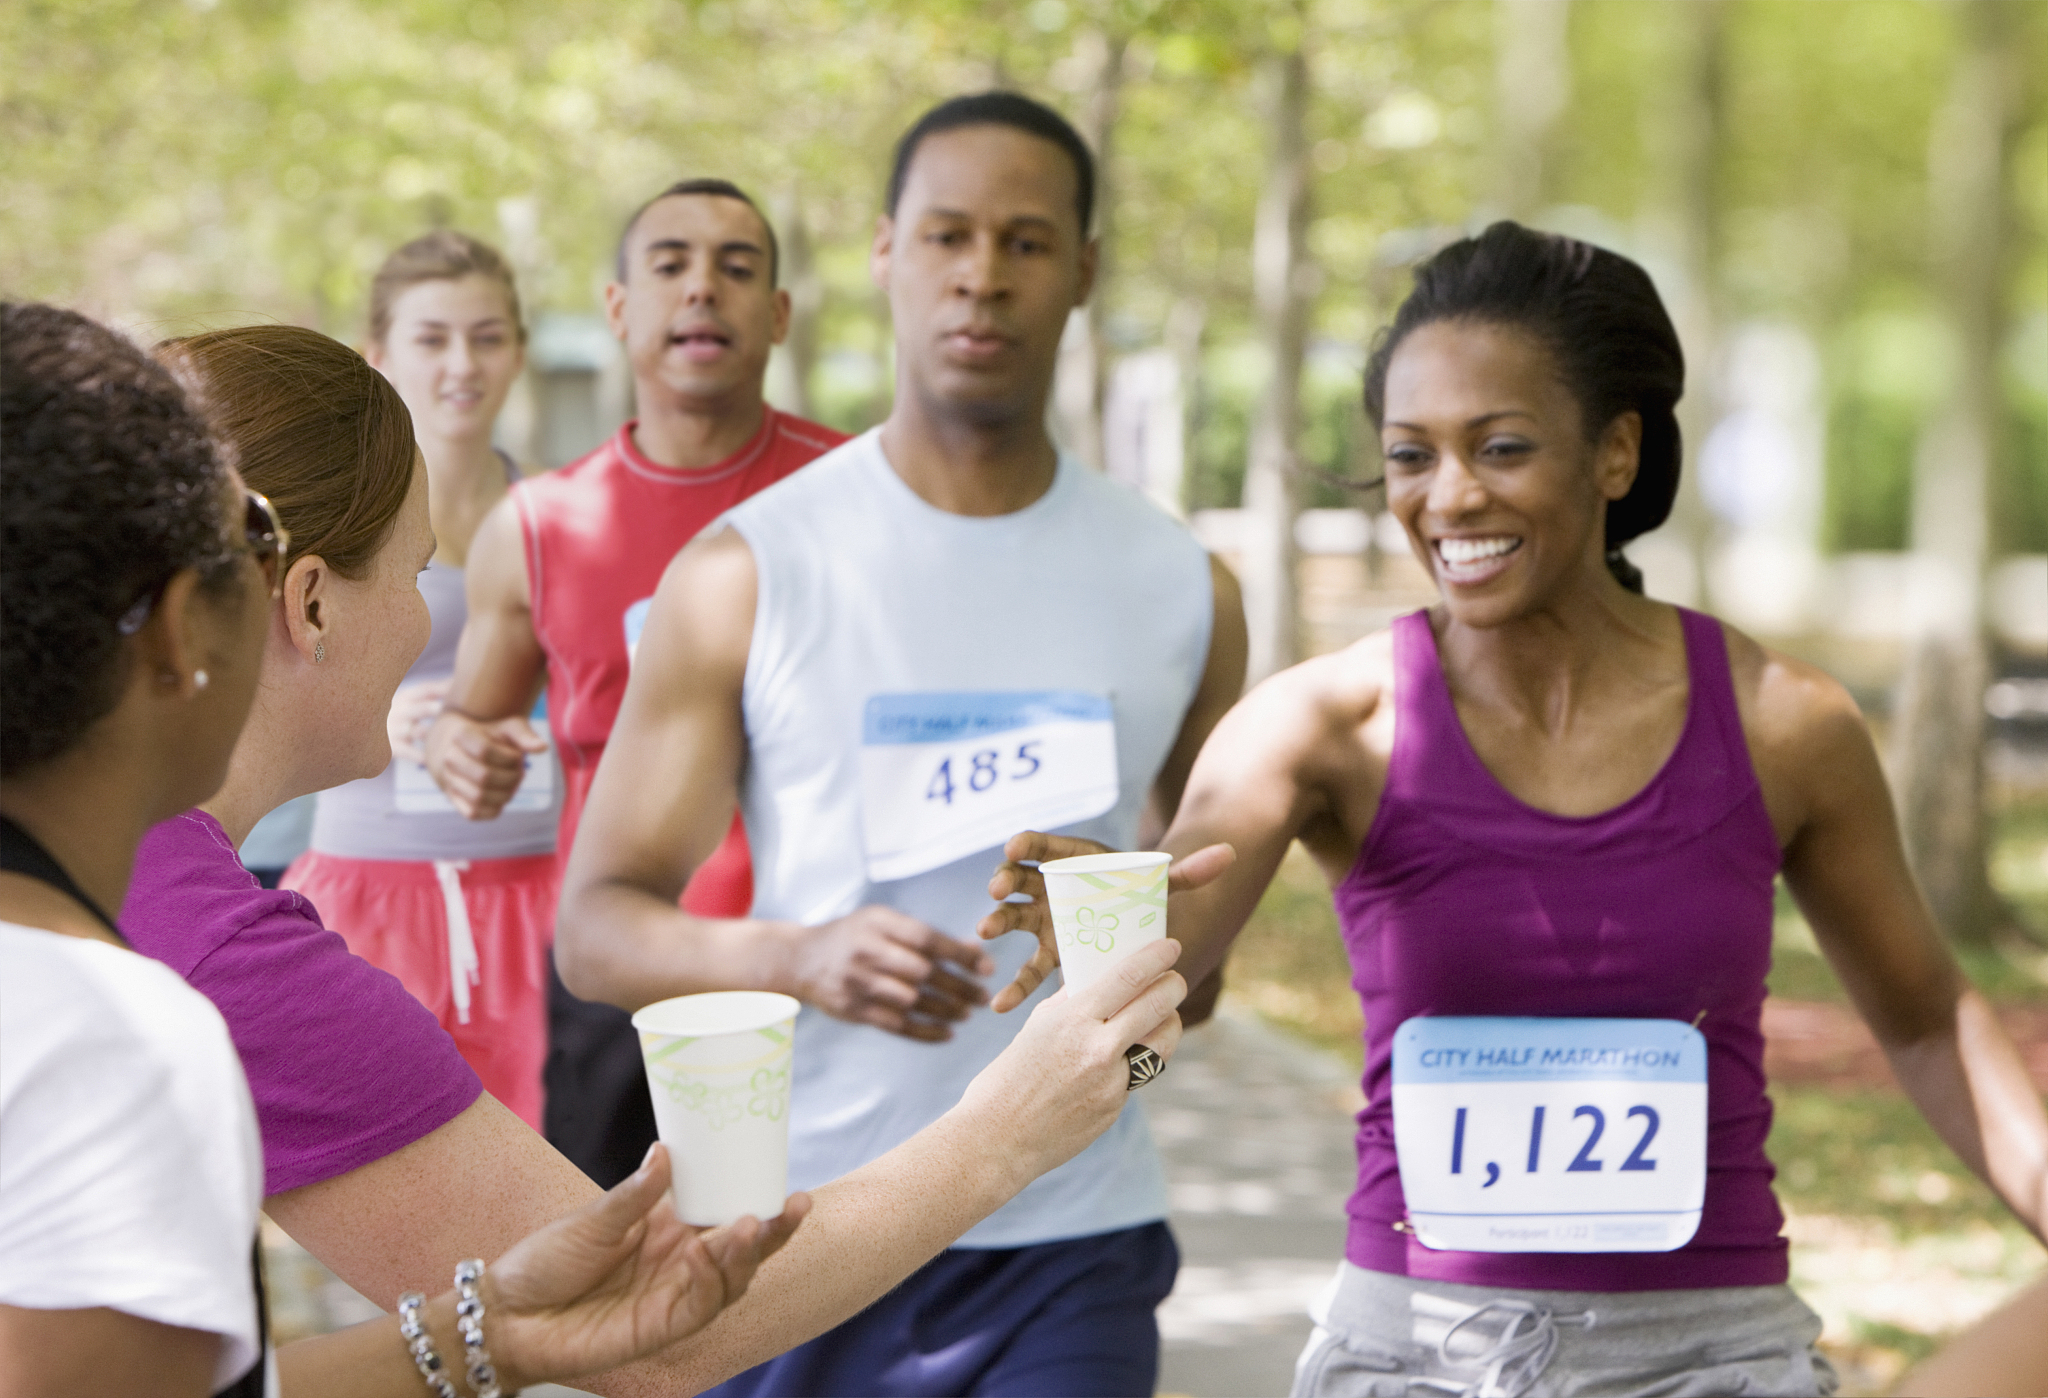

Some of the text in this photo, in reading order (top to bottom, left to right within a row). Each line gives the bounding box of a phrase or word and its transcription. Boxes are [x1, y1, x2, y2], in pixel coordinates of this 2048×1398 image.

[925, 740, 1043, 804] 485
[1419, 1047, 1681, 1069] CITY HALF MARATHON
[1450, 1104, 1661, 1189] 1,122
